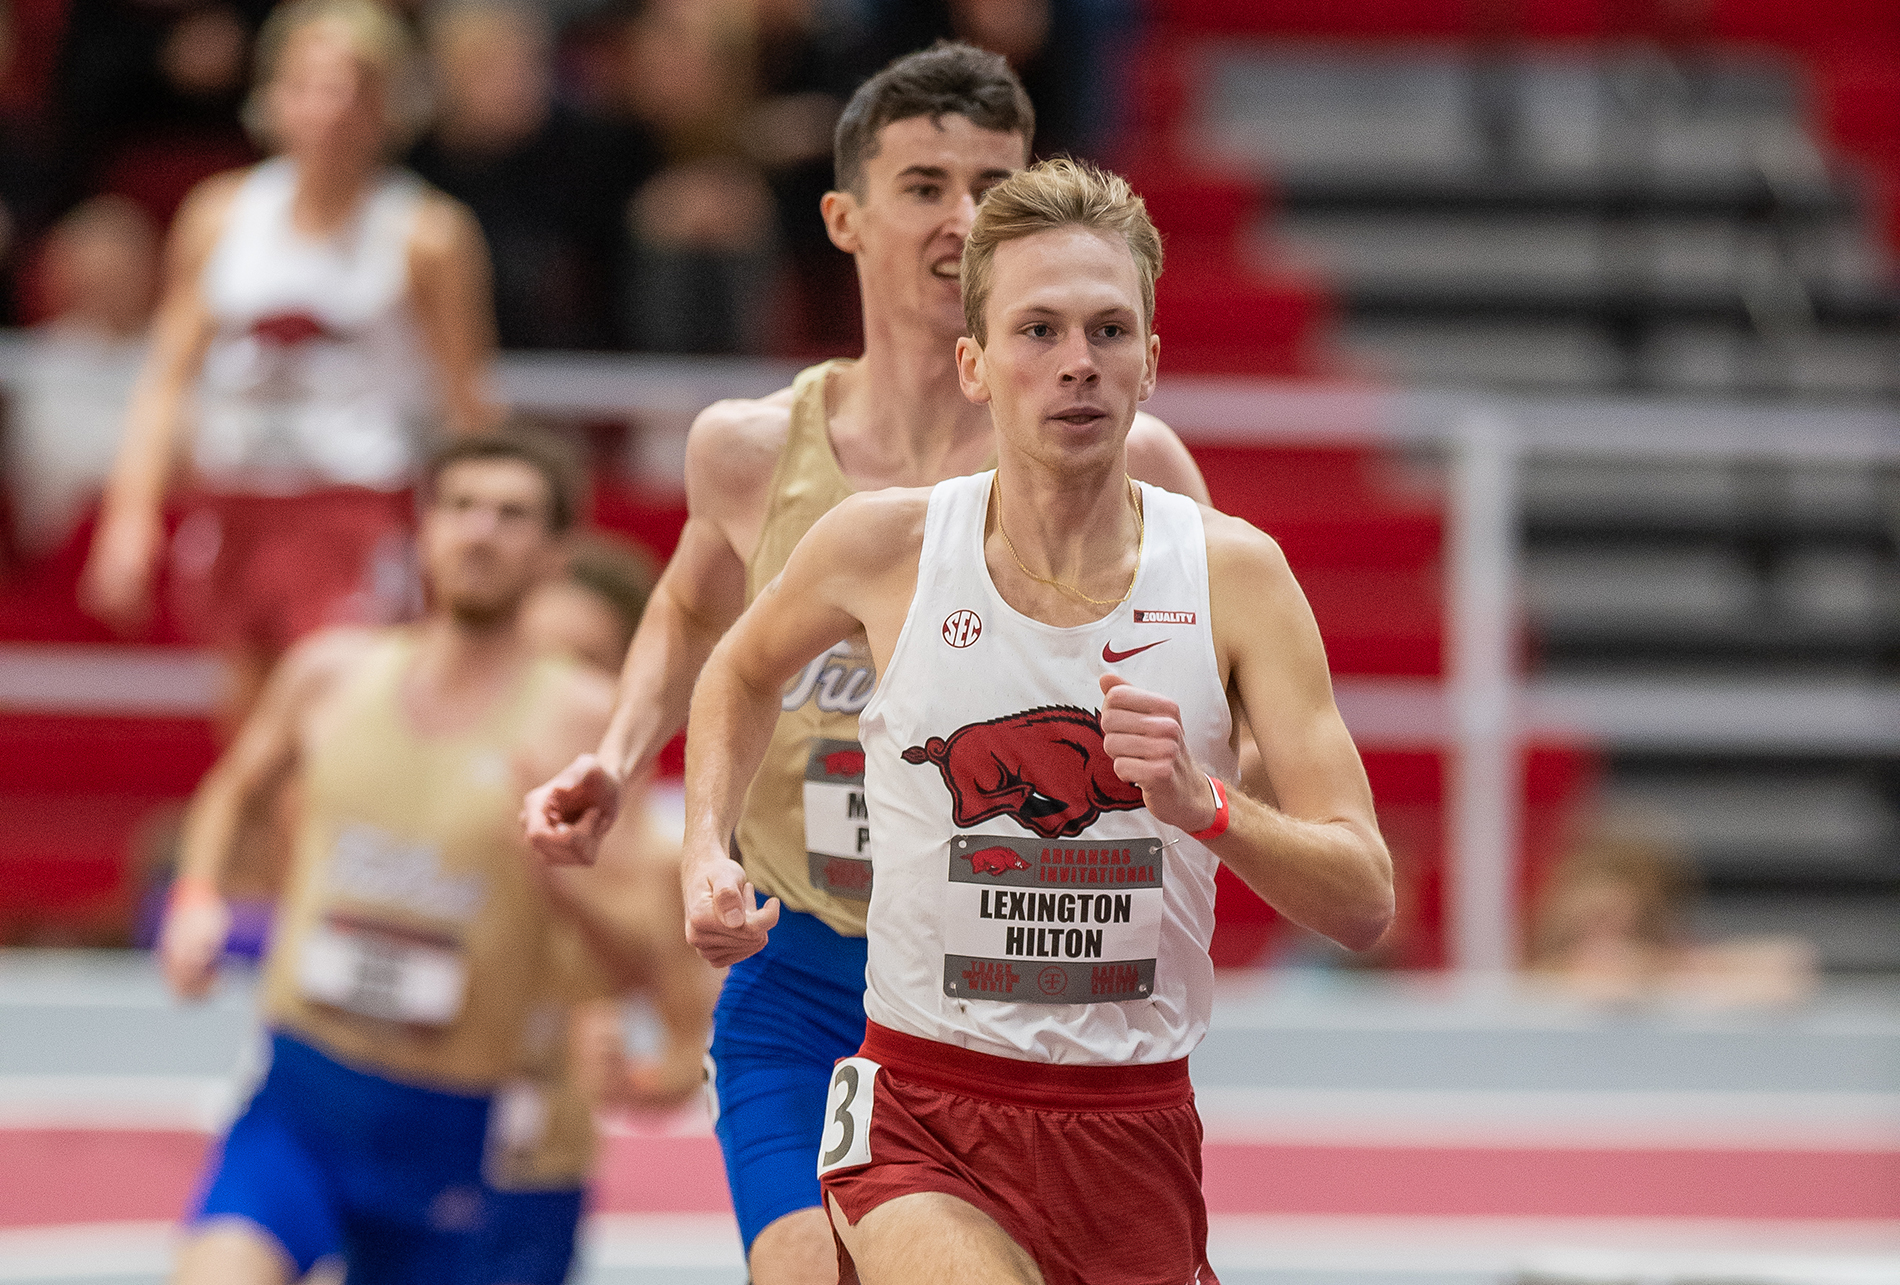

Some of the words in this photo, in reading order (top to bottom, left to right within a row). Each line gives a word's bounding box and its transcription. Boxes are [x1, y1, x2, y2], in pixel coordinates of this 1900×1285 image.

[943, 610, 981, 648] SEC
[1142, 611, 1194, 623] EQUALITY
[1040, 848, 1131, 865] ARKANSAS
[1040, 866, 1155, 883] INVITATIONAL
[979, 889, 1132, 923] LEXINGTON
[1005, 926, 1103, 958] HILTON
[822, 1065, 859, 1167] 3
